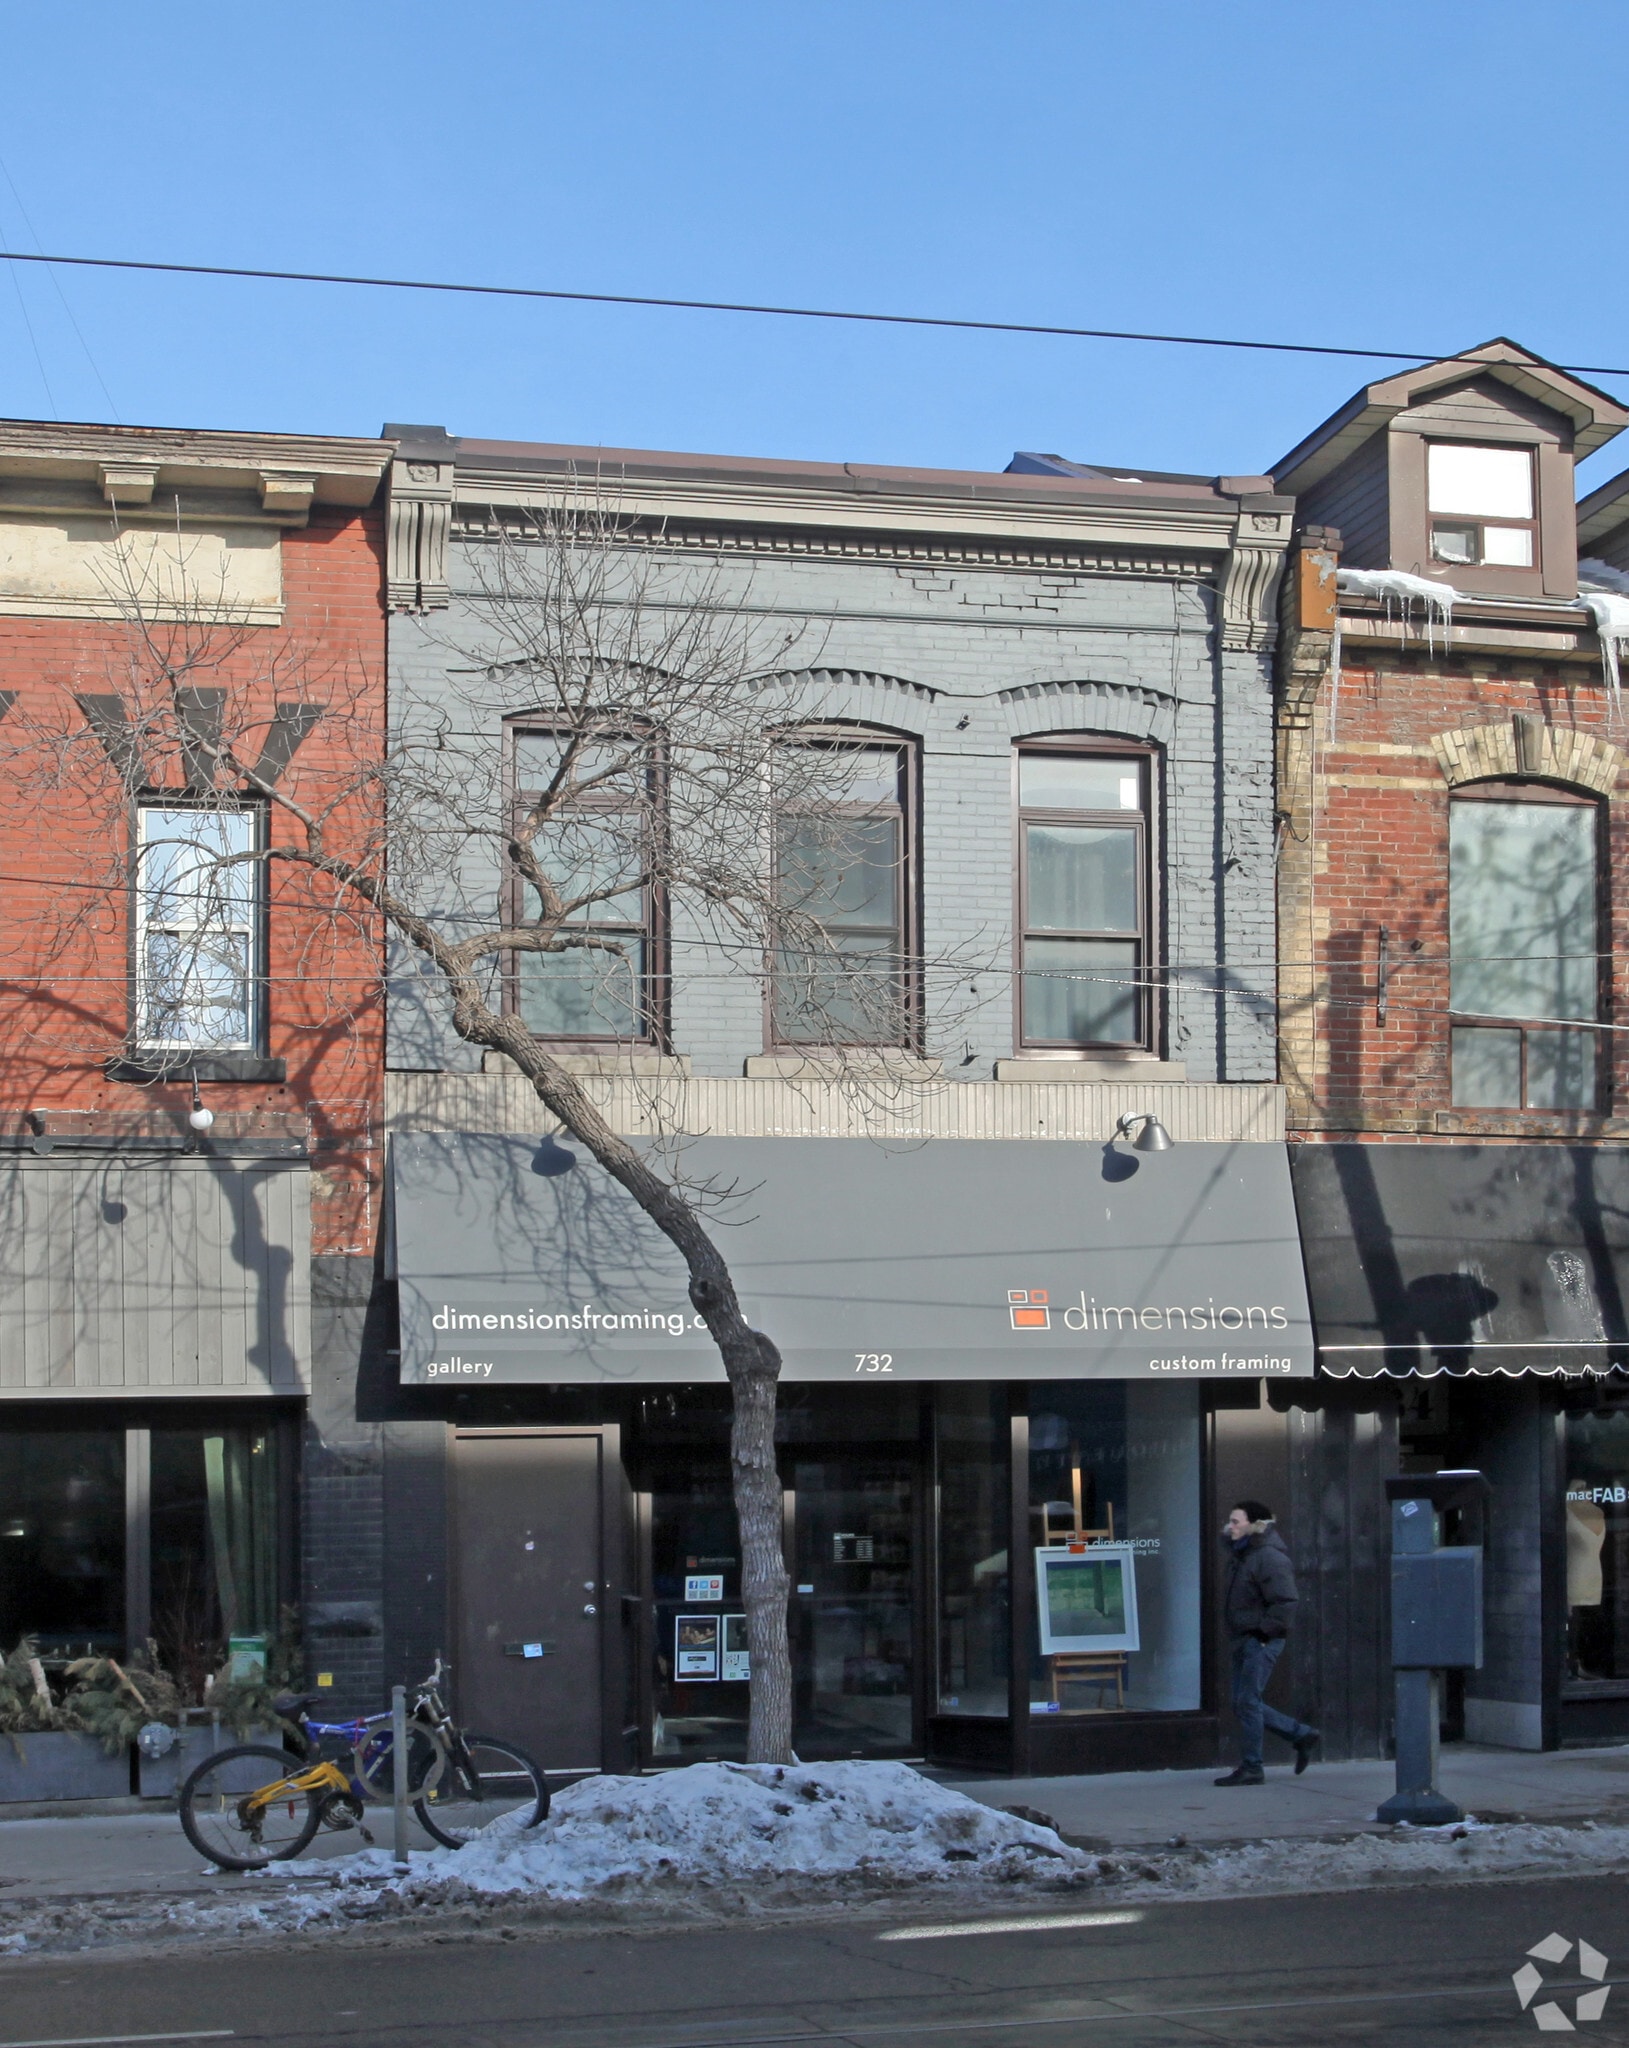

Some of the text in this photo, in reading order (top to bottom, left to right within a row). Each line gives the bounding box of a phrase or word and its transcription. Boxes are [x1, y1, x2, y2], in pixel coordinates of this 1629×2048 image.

[1063, 1290, 1288, 1331] dimensions
[427, 1356, 494, 1378] gallery
[854, 1353, 893, 1373] 732
[1149, 1352, 1292, 1373] custom framing
